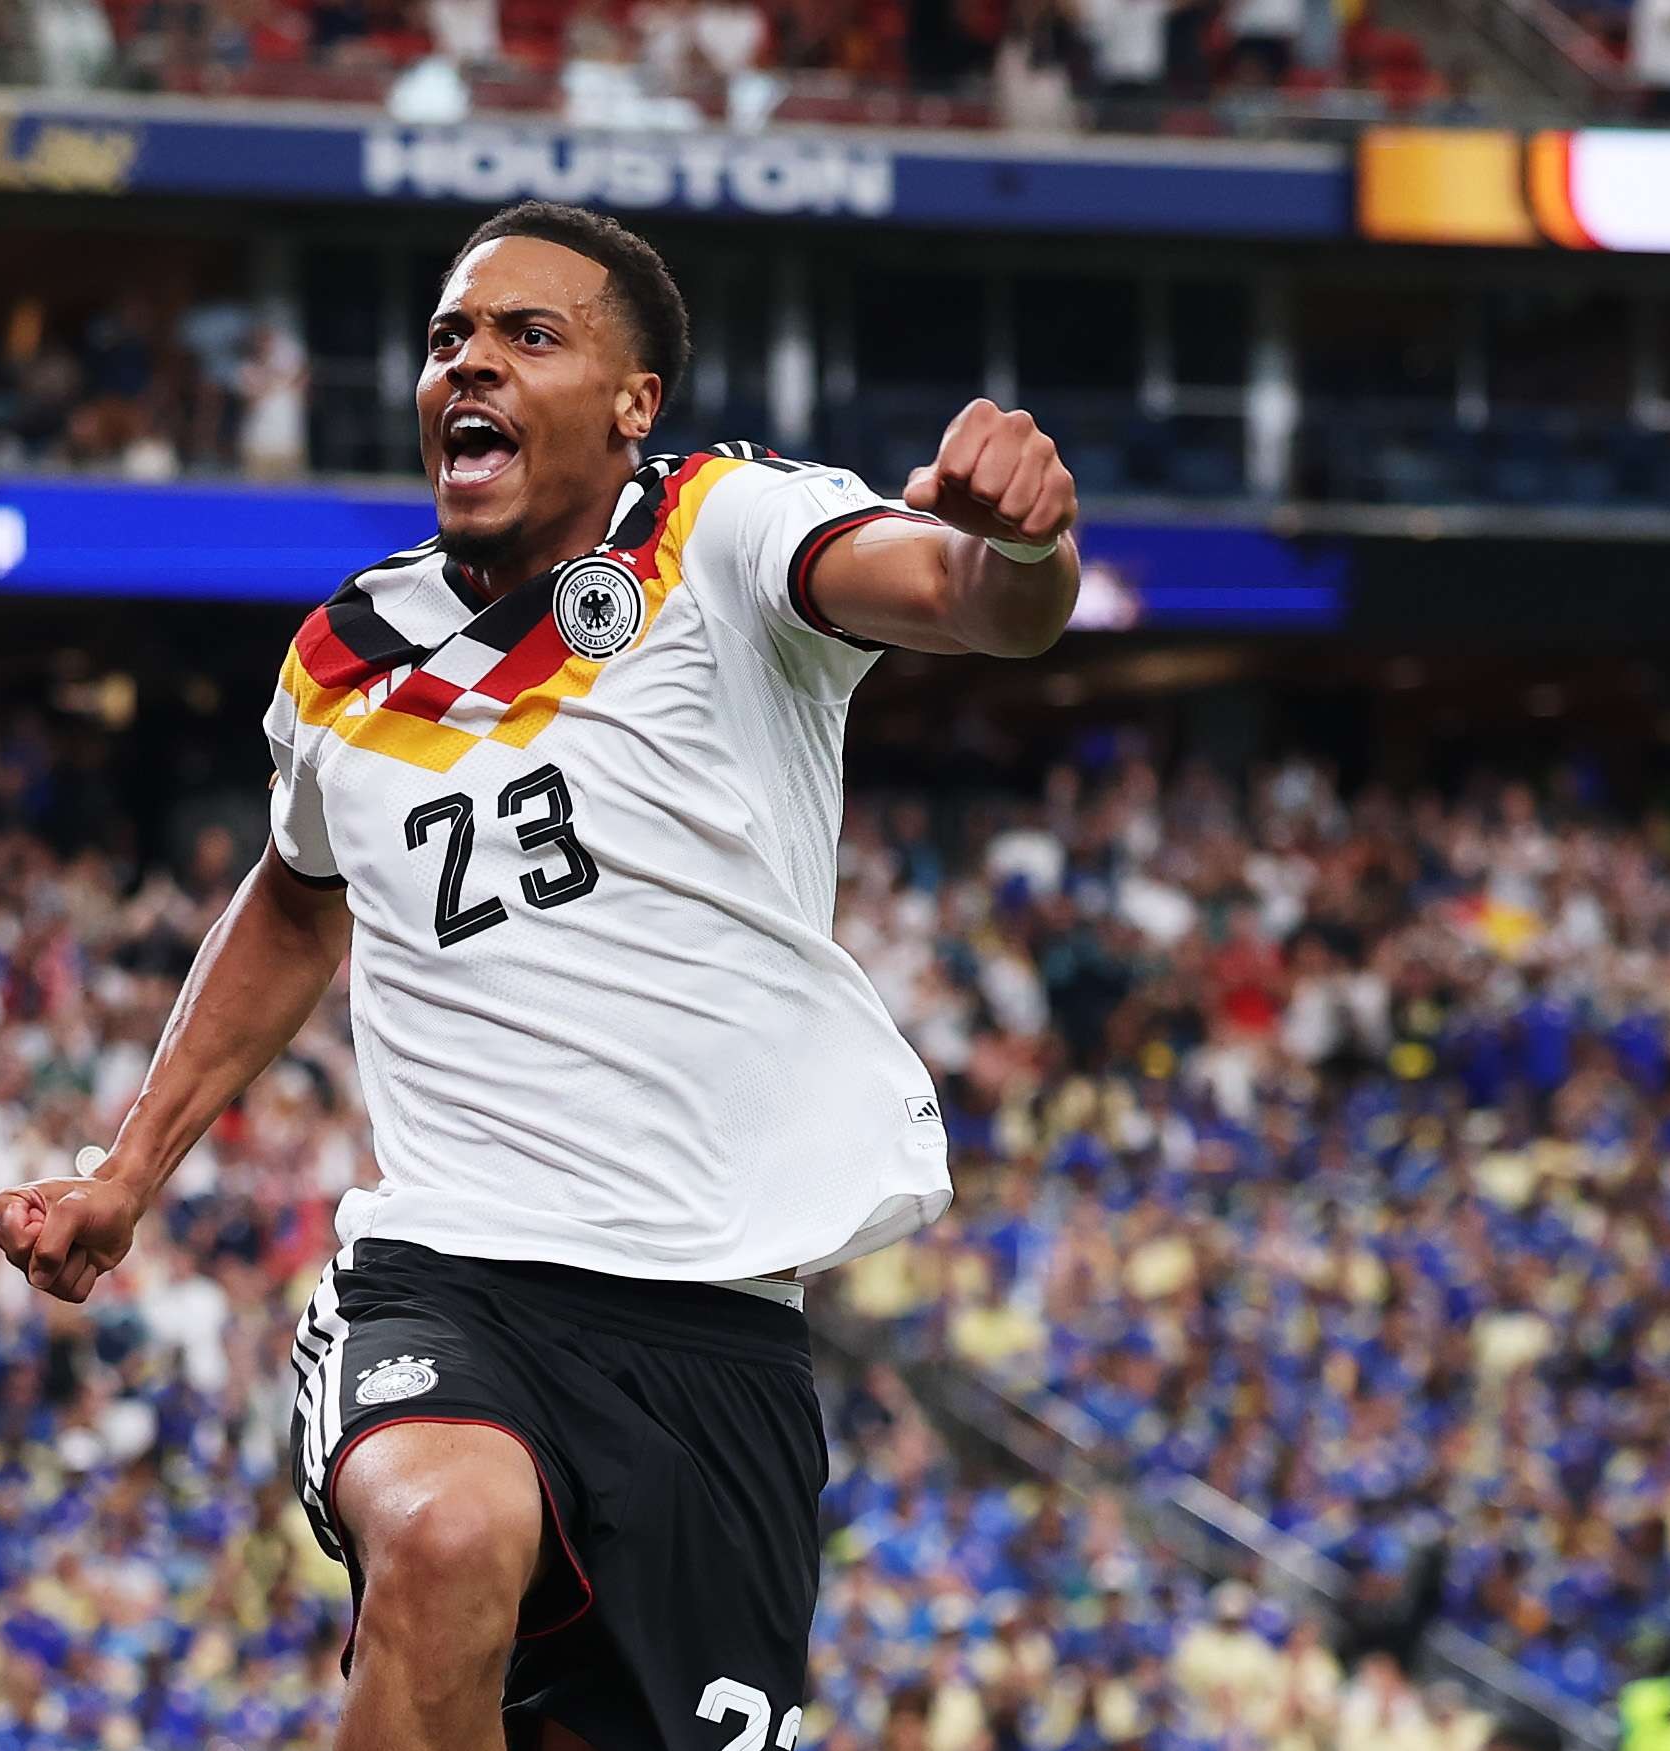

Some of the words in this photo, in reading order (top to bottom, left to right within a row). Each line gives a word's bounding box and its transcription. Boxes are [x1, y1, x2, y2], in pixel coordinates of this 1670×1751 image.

[362, 129, 893, 217] HOUSTON
[570, 574, 619, 595] DEUTSCHER
[570, 616, 628, 646] FUSSBALL-BUND
[404, 762, 600, 949] 23
